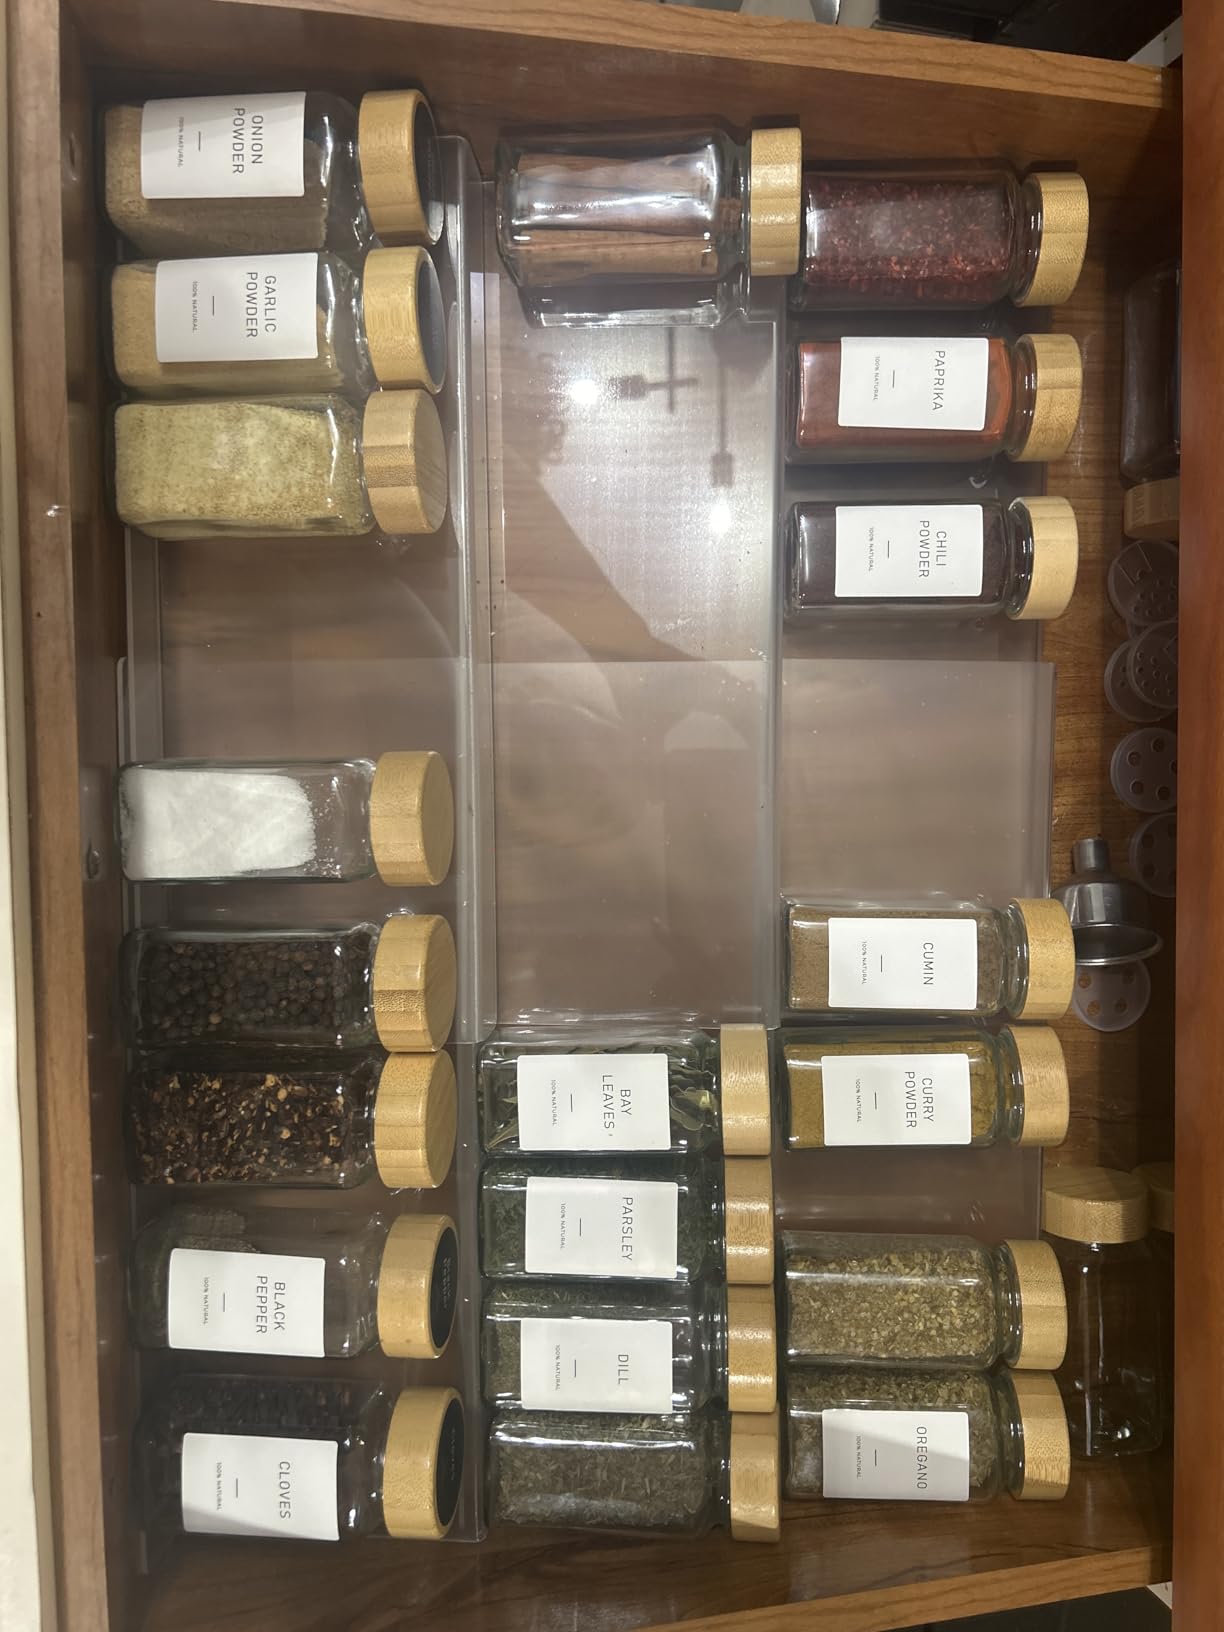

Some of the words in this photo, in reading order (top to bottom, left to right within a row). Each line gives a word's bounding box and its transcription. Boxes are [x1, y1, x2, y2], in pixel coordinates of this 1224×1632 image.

[231, 107, 246, 174] POWDER
[250, 115, 264, 164] ONION
[191, 280, 199, 298] 100%
[245, 271, 259, 338] POWDER
[263, 275, 277, 333] GARLIC
[872, 372, 880, 401] NATURAL
[931, 350, 946, 411] PAPRIKA
[918, 520, 931, 578] POWDER
[935, 530, 948, 566] CHILI
[922, 942, 935, 985] CUMIN
[602, 1074, 615, 1129] LEAVES
[619, 1089, 633, 1116] BAY
[904, 1071, 918, 1128] POWDER
[921, 1077, 935, 1122] CURRY
[621, 1196, 634, 1261] PARSLEY
[202, 1276, 210, 1294] 100%
[255, 1275, 269, 1334] PEPPER
[273, 1281, 286, 1331] BLACK
[617, 1354, 630, 1385] DILL
[215, 1461, 223, 1479] 100%
[856, 1451, 864, 1479] NATURAL
[916, 1426, 928, 1489] OREGANO
[278, 1461, 292, 1519] CLOVES
